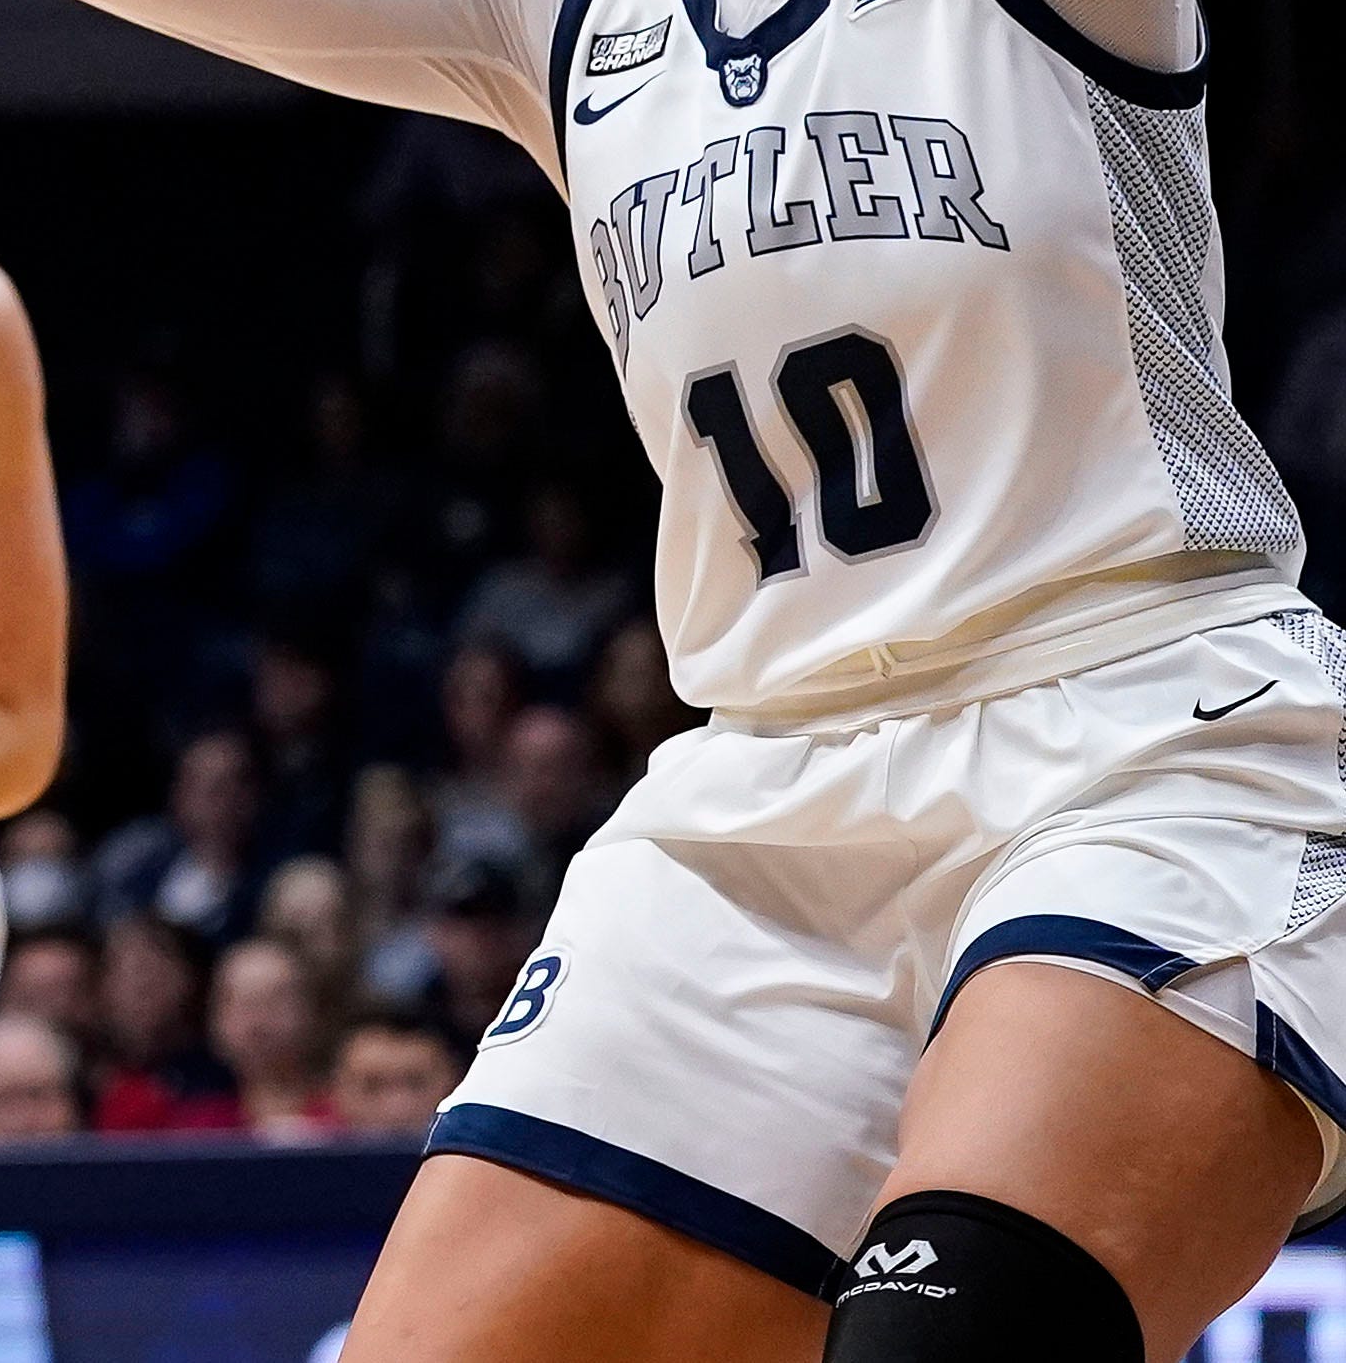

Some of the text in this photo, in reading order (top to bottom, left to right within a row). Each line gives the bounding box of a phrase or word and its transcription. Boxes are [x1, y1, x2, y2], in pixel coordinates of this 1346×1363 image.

[611, 29, 652, 56] BE
[590, 111, 1010, 384] BUTLER
[680, 323, 941, 589] 10
[486, 955, 562, 1038] B
